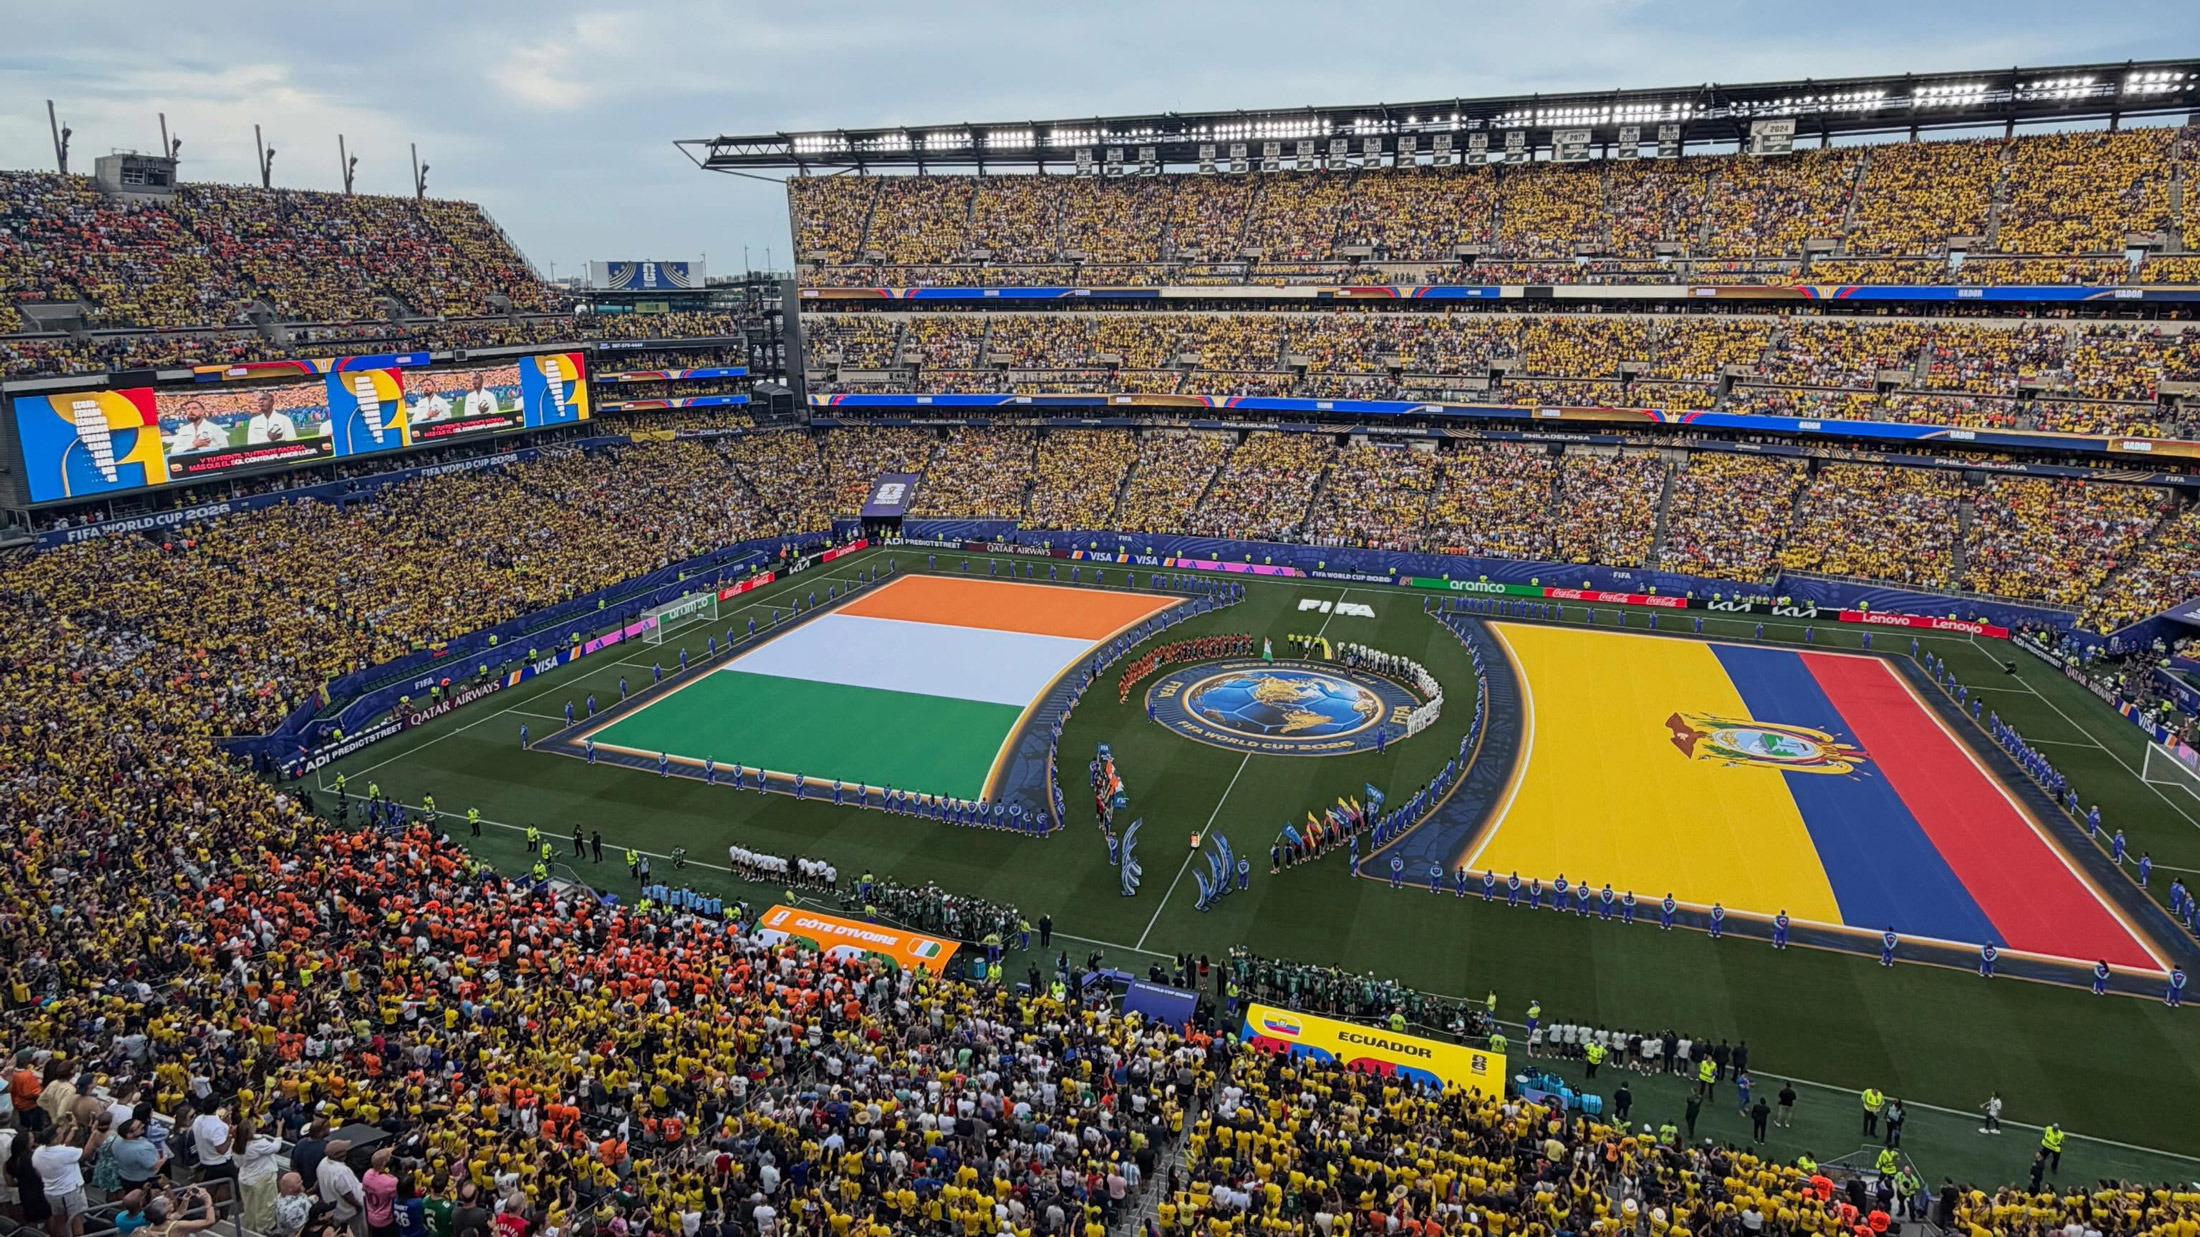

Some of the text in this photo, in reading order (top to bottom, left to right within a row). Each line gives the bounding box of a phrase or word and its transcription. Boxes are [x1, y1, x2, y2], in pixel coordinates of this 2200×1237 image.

[1770, 125, 1789, 133] 2024
[1522, 433, 1591, 441] PHILADELPHIA
[421, 453, 518, 477] FIFA WORLD CUP 2026
[2165, 475, 2185, 483] FIFA
[67, 503, 231, 542] FIFA WORLD CUP 2026
[884, 537, 904, 546] ADI
[987, 544, 1051, 556] QATAR AIRWAYS
[1089, 551, 1113, 562] VISA
[1135, 555, 1159, 566] VISA
[1613, 571, 1631, 579] FIFA
[1450, 580, 1506, 593] aramco
[1552, 588, 1581, 600] Coca-Cola
[1598, 592, 1629, 603] Coca-Cola
[1298, 598, 1375, 618] FIFA
[1646, 596, 1677, 607] Coca-Cola
[1862, 613, 1910, 626] Lenovo
[1932, 618, 1982, 634] Lenovo
[531, 656, 559, 675] VISA
[414, 677, 434, 690] FIFA
[1157, 680, 1185, 699] FIFA
[2065, 664, 2116, 706] QATAR AIRWAYS
[411, 680, 500, 725] QATAR AIRWAYS
[1389, 705, 1410, 724] FIFA
[2137, 712, 2157, 736] VISA
[1177, 720, 1355, 750] FIFA WORLD CUP 2026
[305, 722, 402, 773] ADI PREDICTSTREET
[794, 917, 899, 946] CÔTE D'IVOIRE
[1338, 1031, 1432, 1059] ECUADOR
